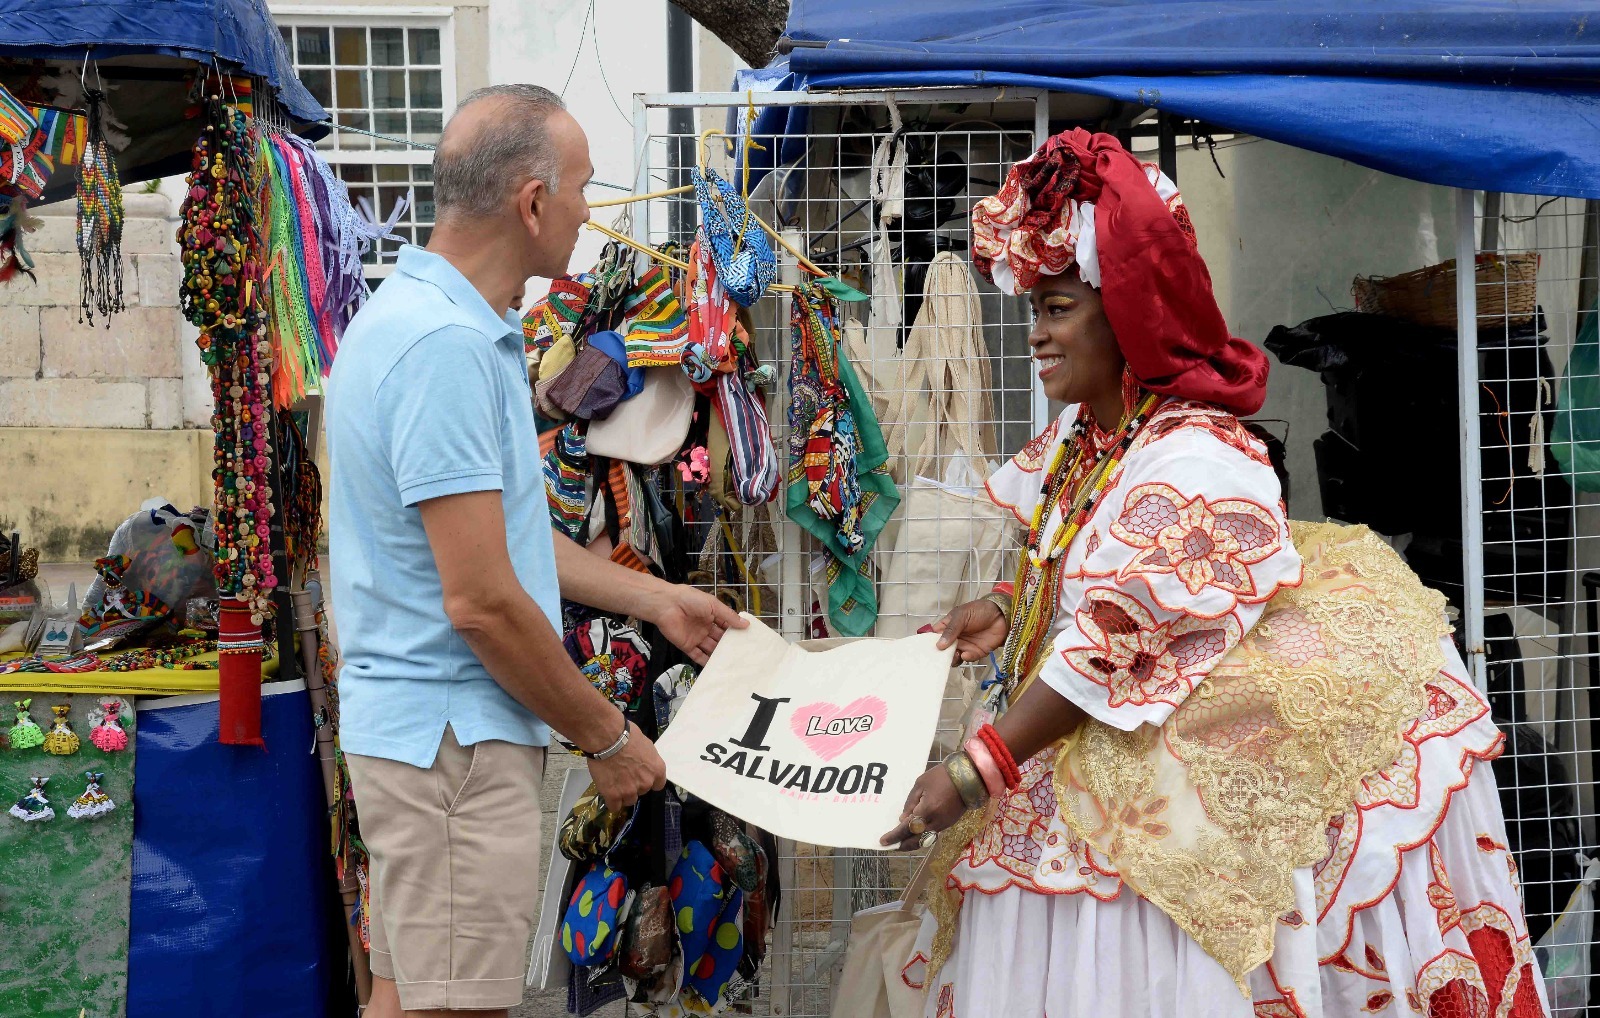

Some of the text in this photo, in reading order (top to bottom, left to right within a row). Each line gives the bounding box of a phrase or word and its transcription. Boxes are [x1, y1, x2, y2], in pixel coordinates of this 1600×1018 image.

[728, 692, 874, 752] I Love
[699, 742, 889, 795] SALVADOR
[779, 787, 820, 804] BAHIA
[832, 792, 881, 805] BRASIL
